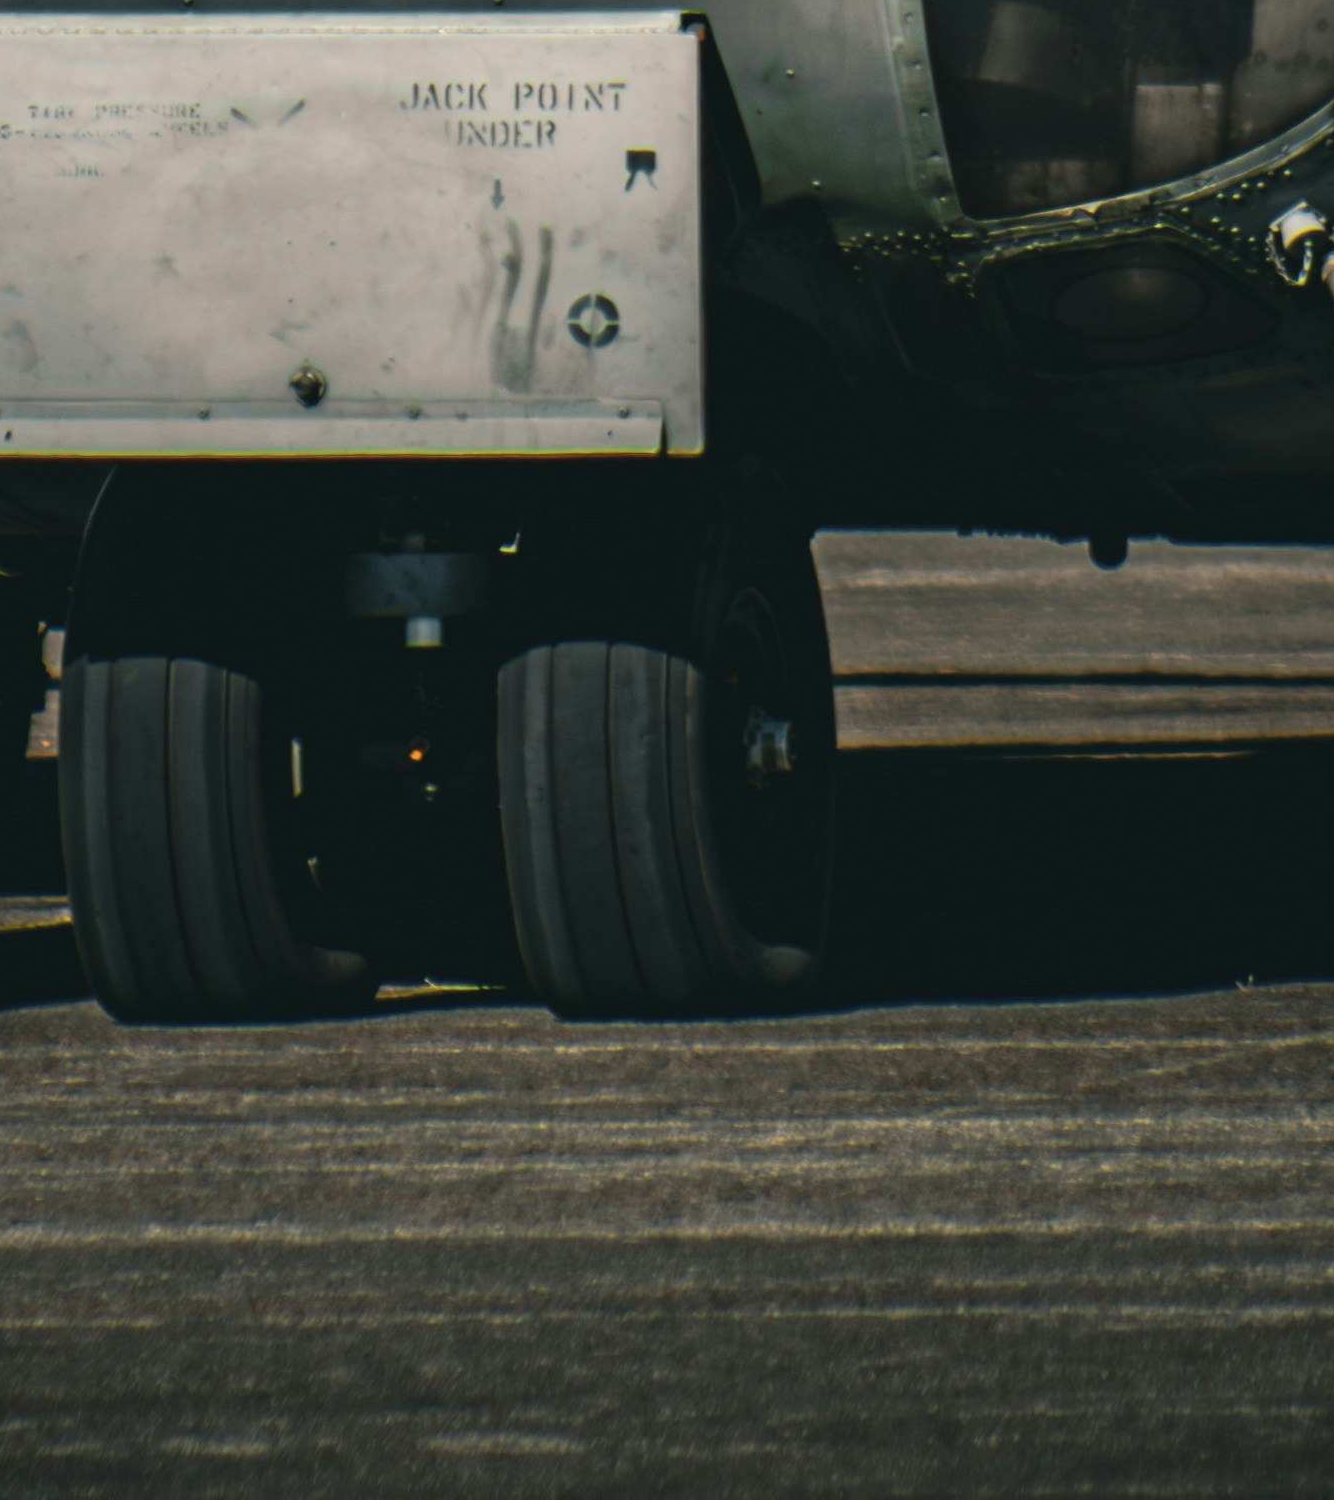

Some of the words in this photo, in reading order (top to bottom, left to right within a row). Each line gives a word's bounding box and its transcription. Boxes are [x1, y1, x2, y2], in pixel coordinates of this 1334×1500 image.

[398, 80, 489, 112] JACK
[513, 79, 627, 112] POINT
[444, 117, 557, 148] UNDER
